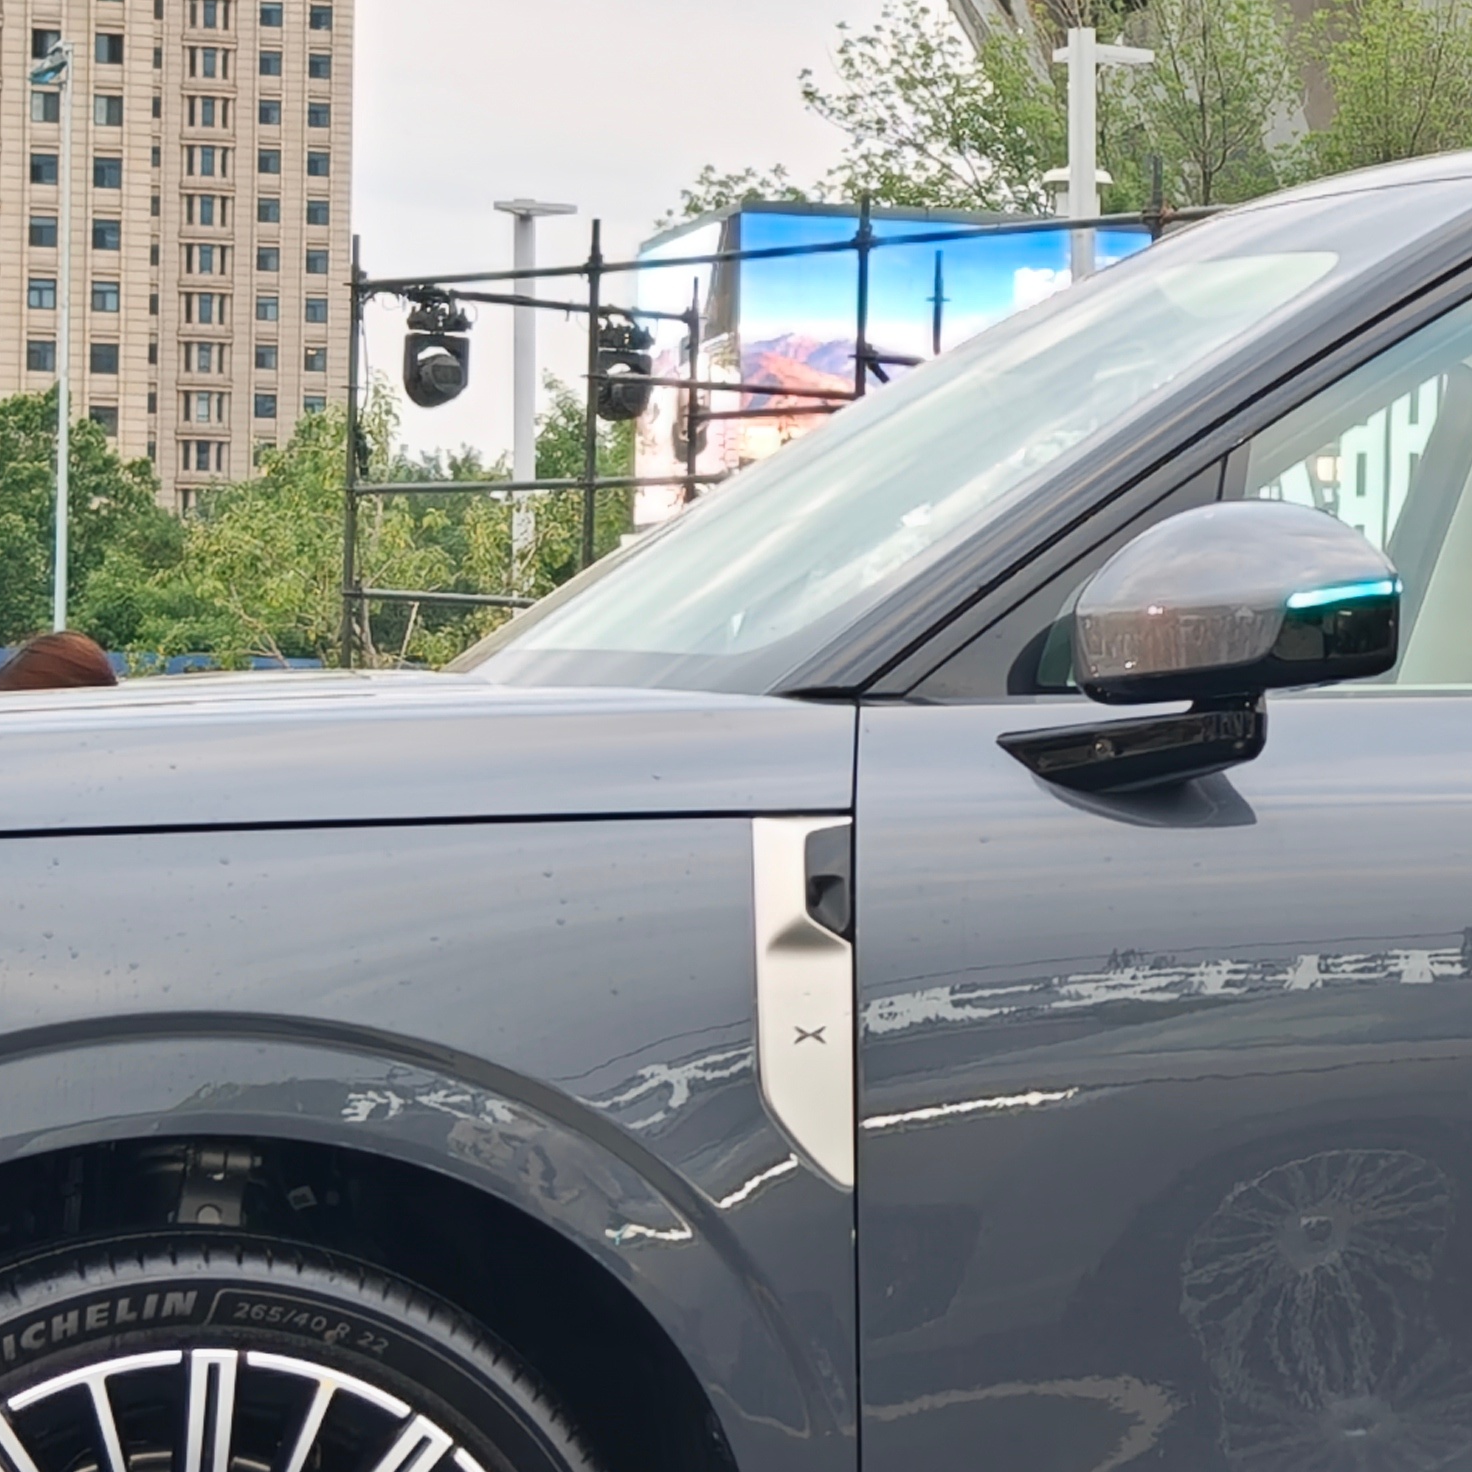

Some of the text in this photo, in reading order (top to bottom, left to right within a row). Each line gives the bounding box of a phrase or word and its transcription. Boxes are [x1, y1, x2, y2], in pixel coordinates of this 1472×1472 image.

[235, 1301, 390, 1355] 265/40 R 22
